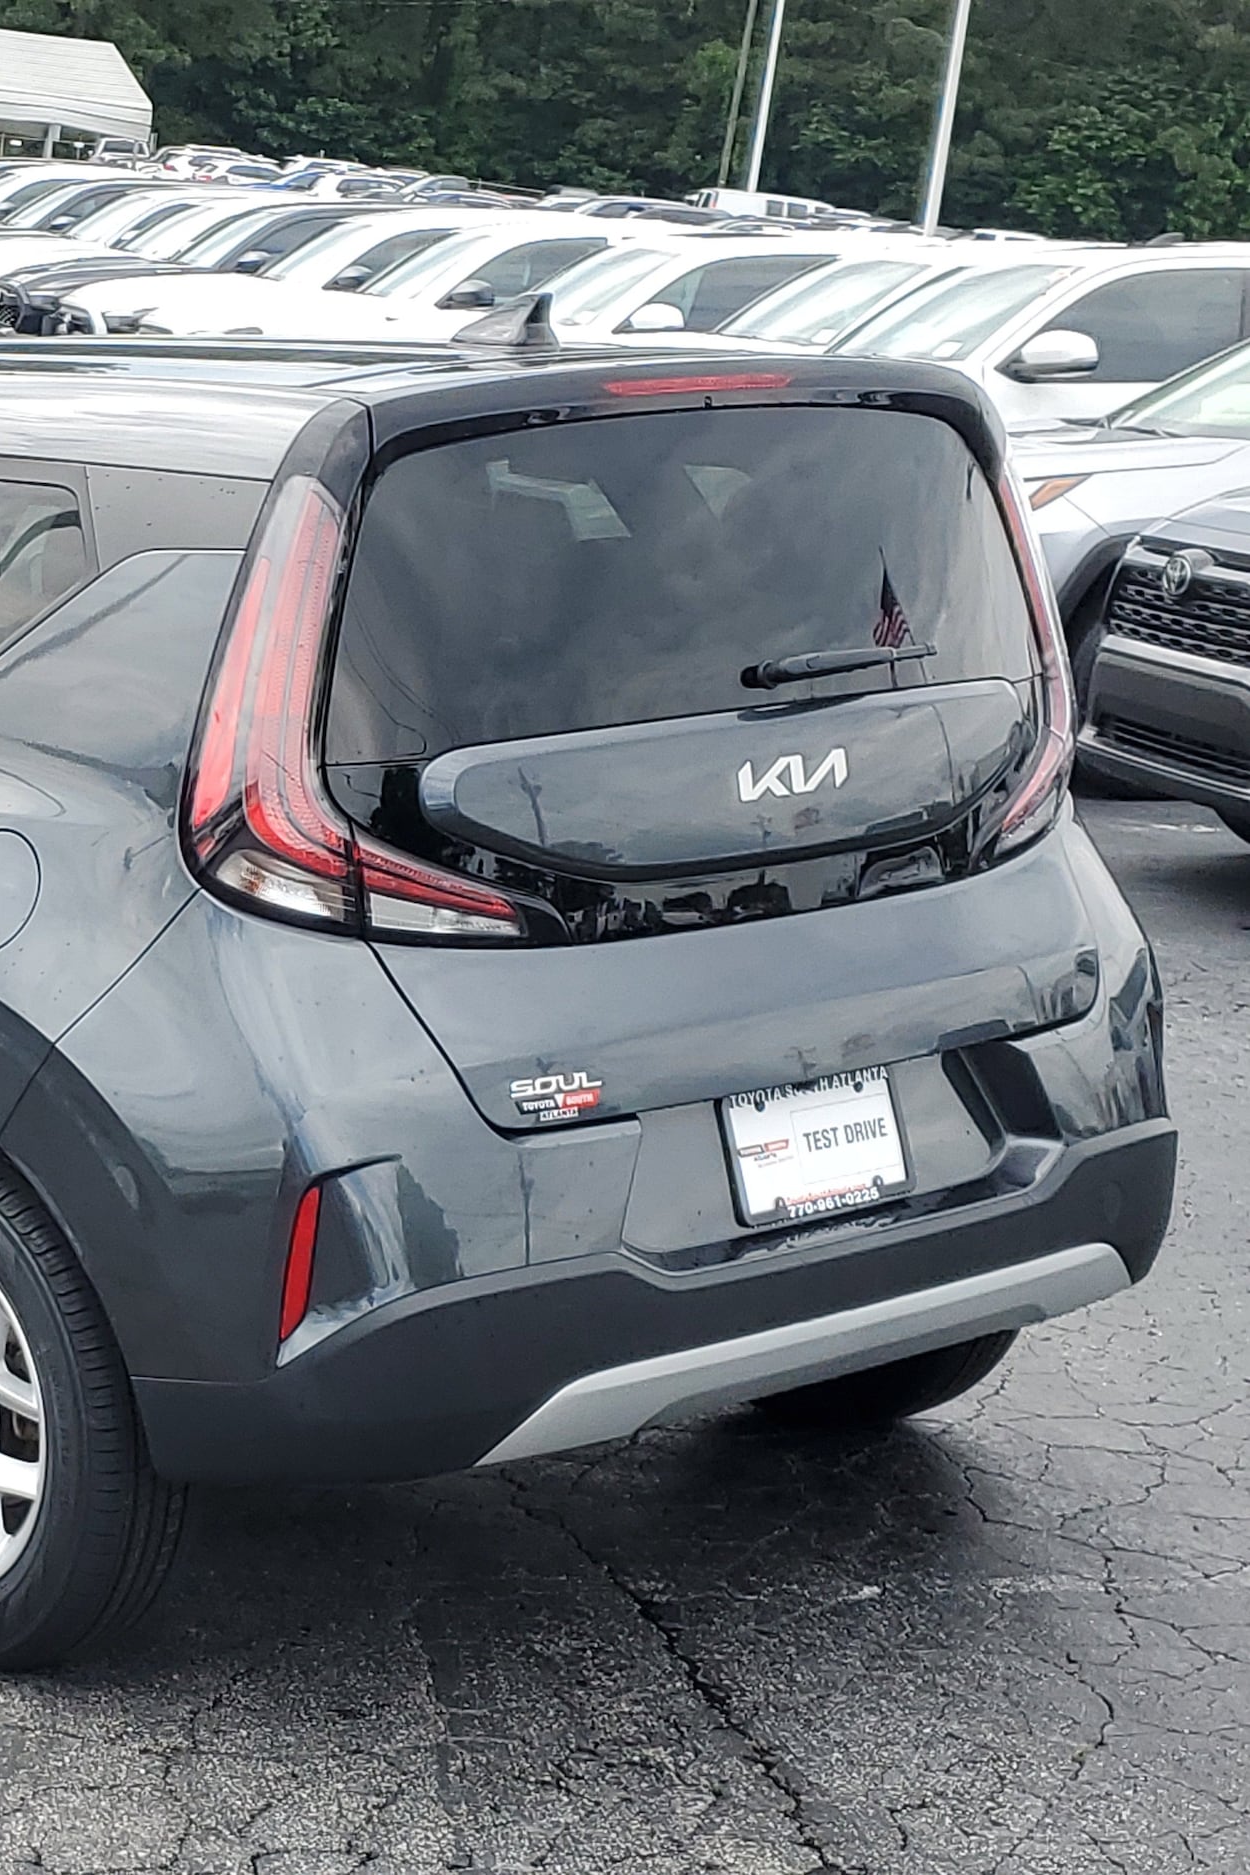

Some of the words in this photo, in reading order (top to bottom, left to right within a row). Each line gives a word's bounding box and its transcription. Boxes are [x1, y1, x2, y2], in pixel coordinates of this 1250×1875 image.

[738, 748, 848, 802] KIA
[511, 1072, 602, 1099] SOUL
[730, 1087, 783, 1108] TOYOTA
[832, 1066, 889, 1089] ATLANTA
[522, 1099, 556, 1111] TOYOTA
[541, 1108, 578, 1120] ATLANTA
[803, 1127, 839, 1153] TEST
[844, 1117, 888, 1144] DRIVE
